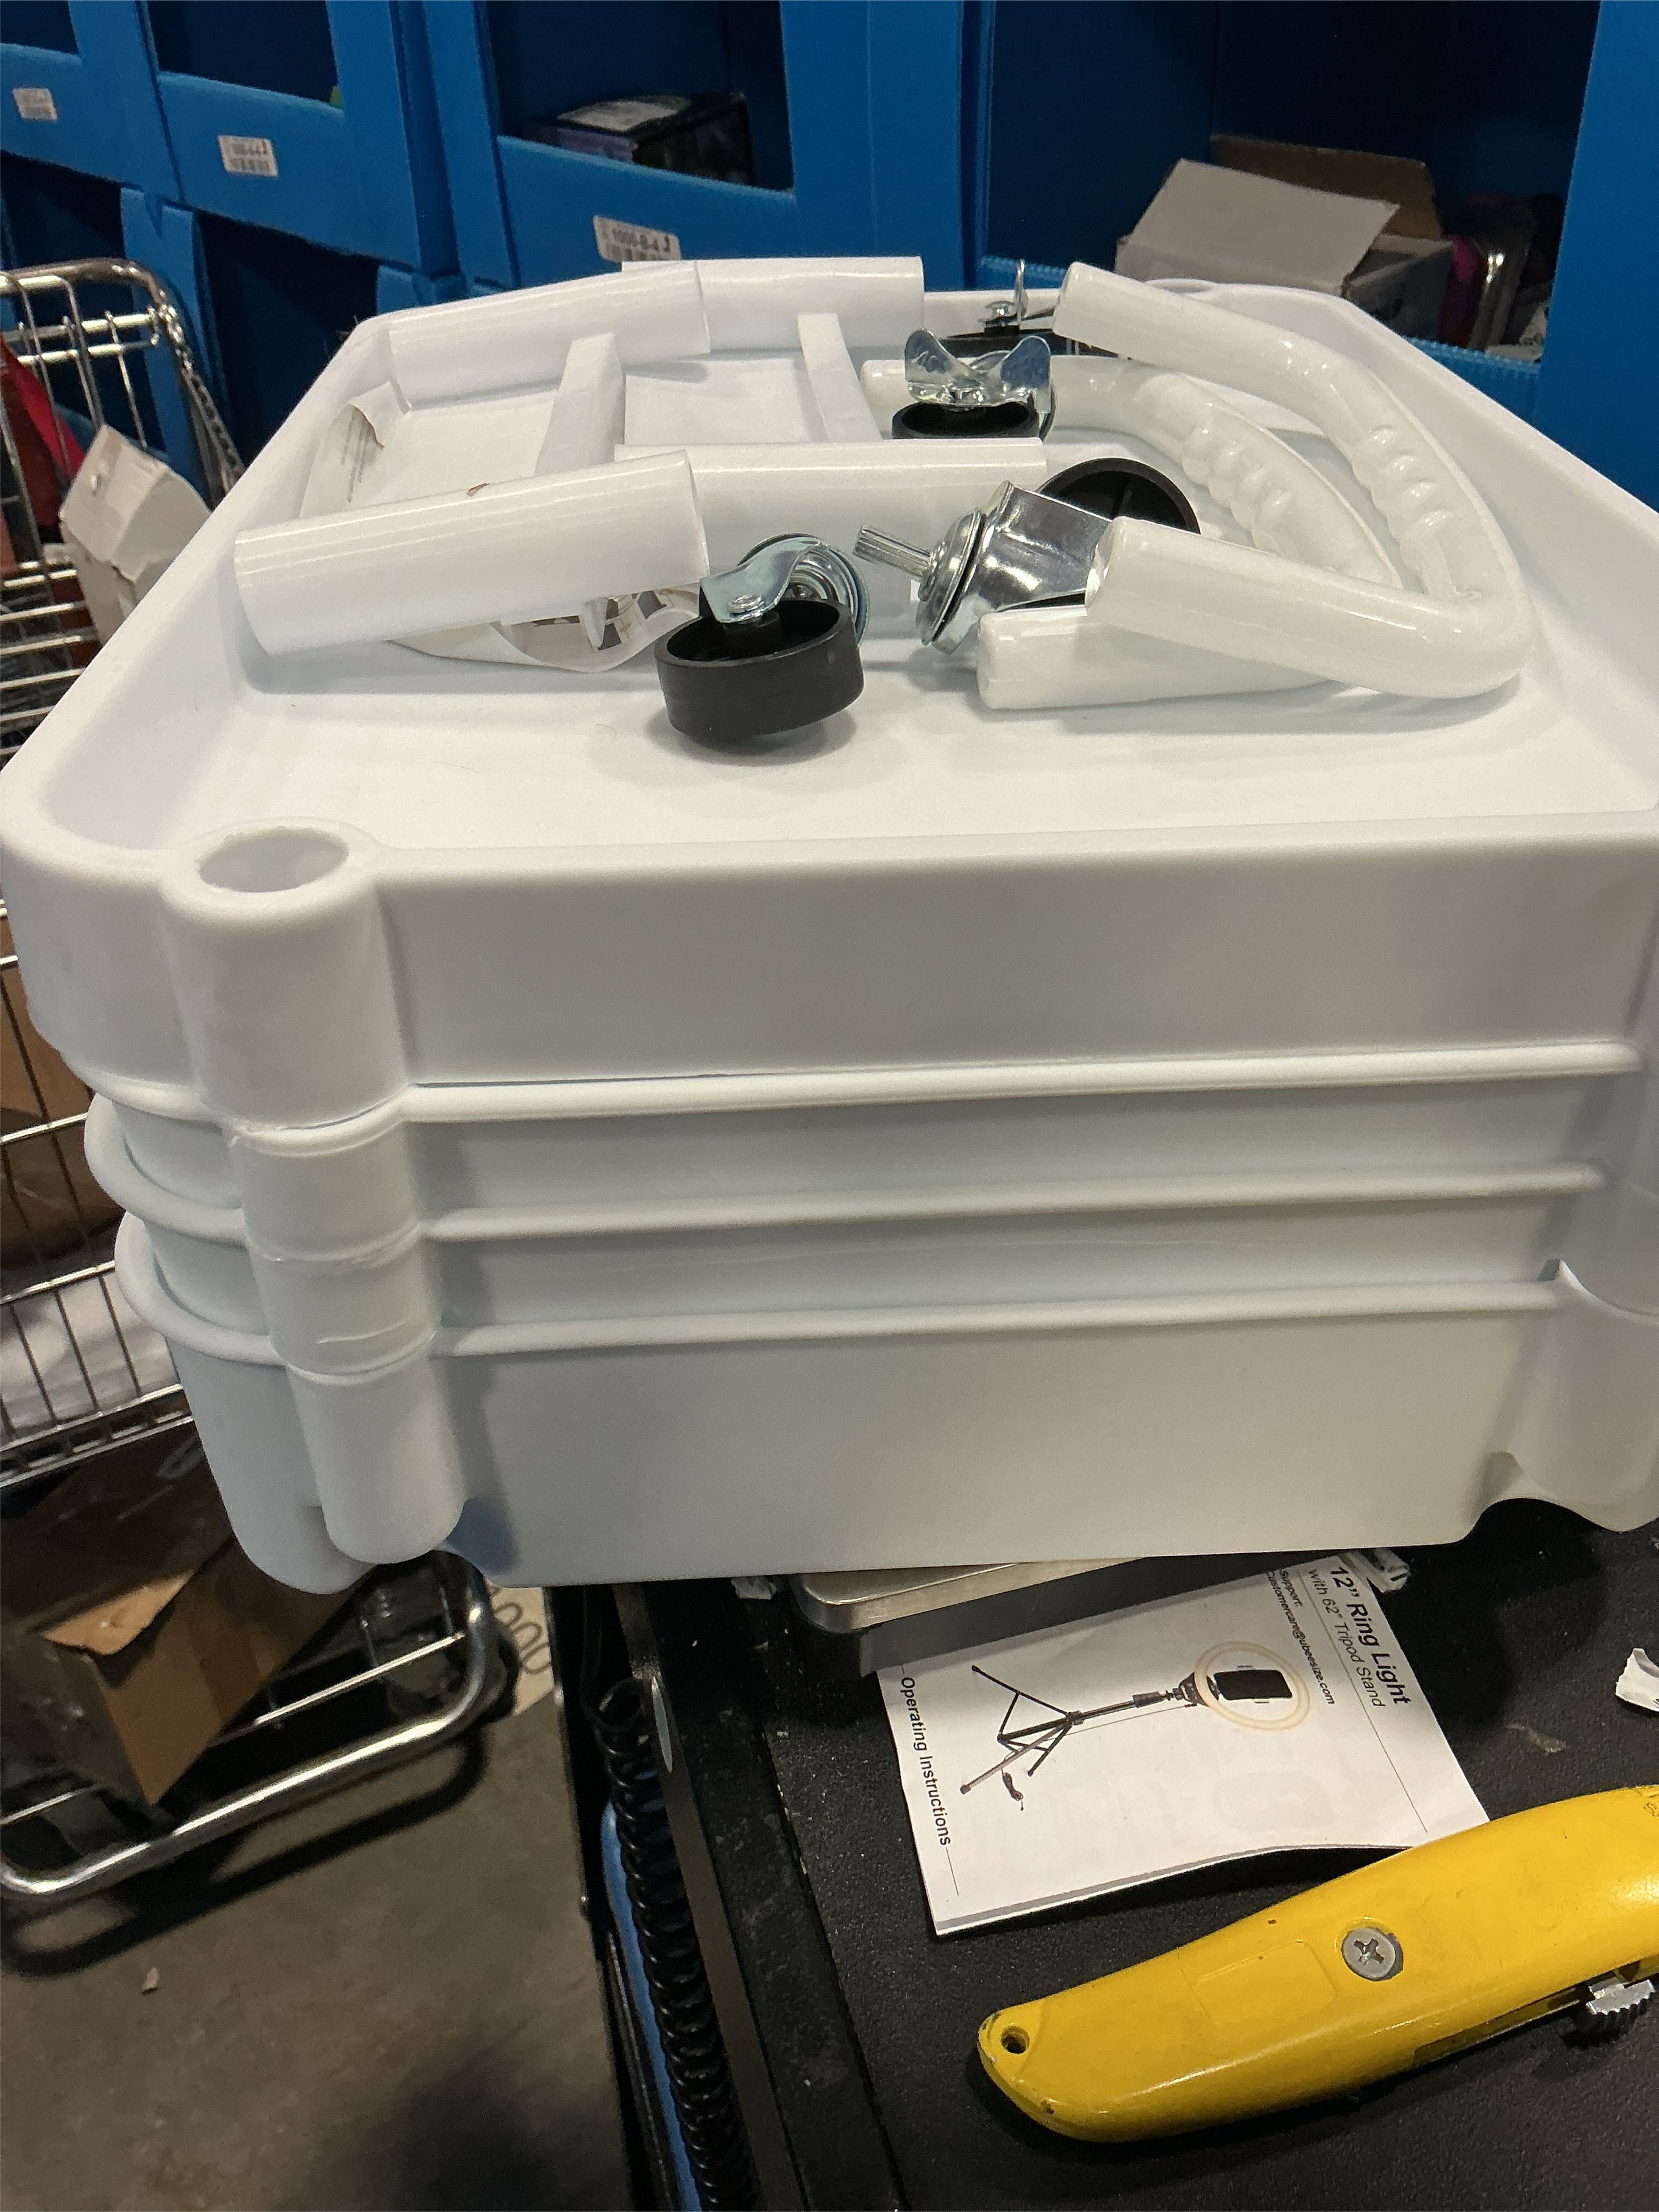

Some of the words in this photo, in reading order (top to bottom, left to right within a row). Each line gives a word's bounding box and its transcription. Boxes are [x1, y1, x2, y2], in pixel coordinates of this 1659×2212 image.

[1309, 1570, 1328, 1595] with
[1335, 1622, 1365, 1663] Tripod
[1356, 1666, 1386, 1707] Stand
[1330, 1567, 1360, 1597] 12”
[1346, 1603, 1380, 1647] Ring
[1371, 1652, 1412, 1704] Light
[900, 1677, 927, 1751] Operating
[919, 1755, 951, 1846] Instructions
